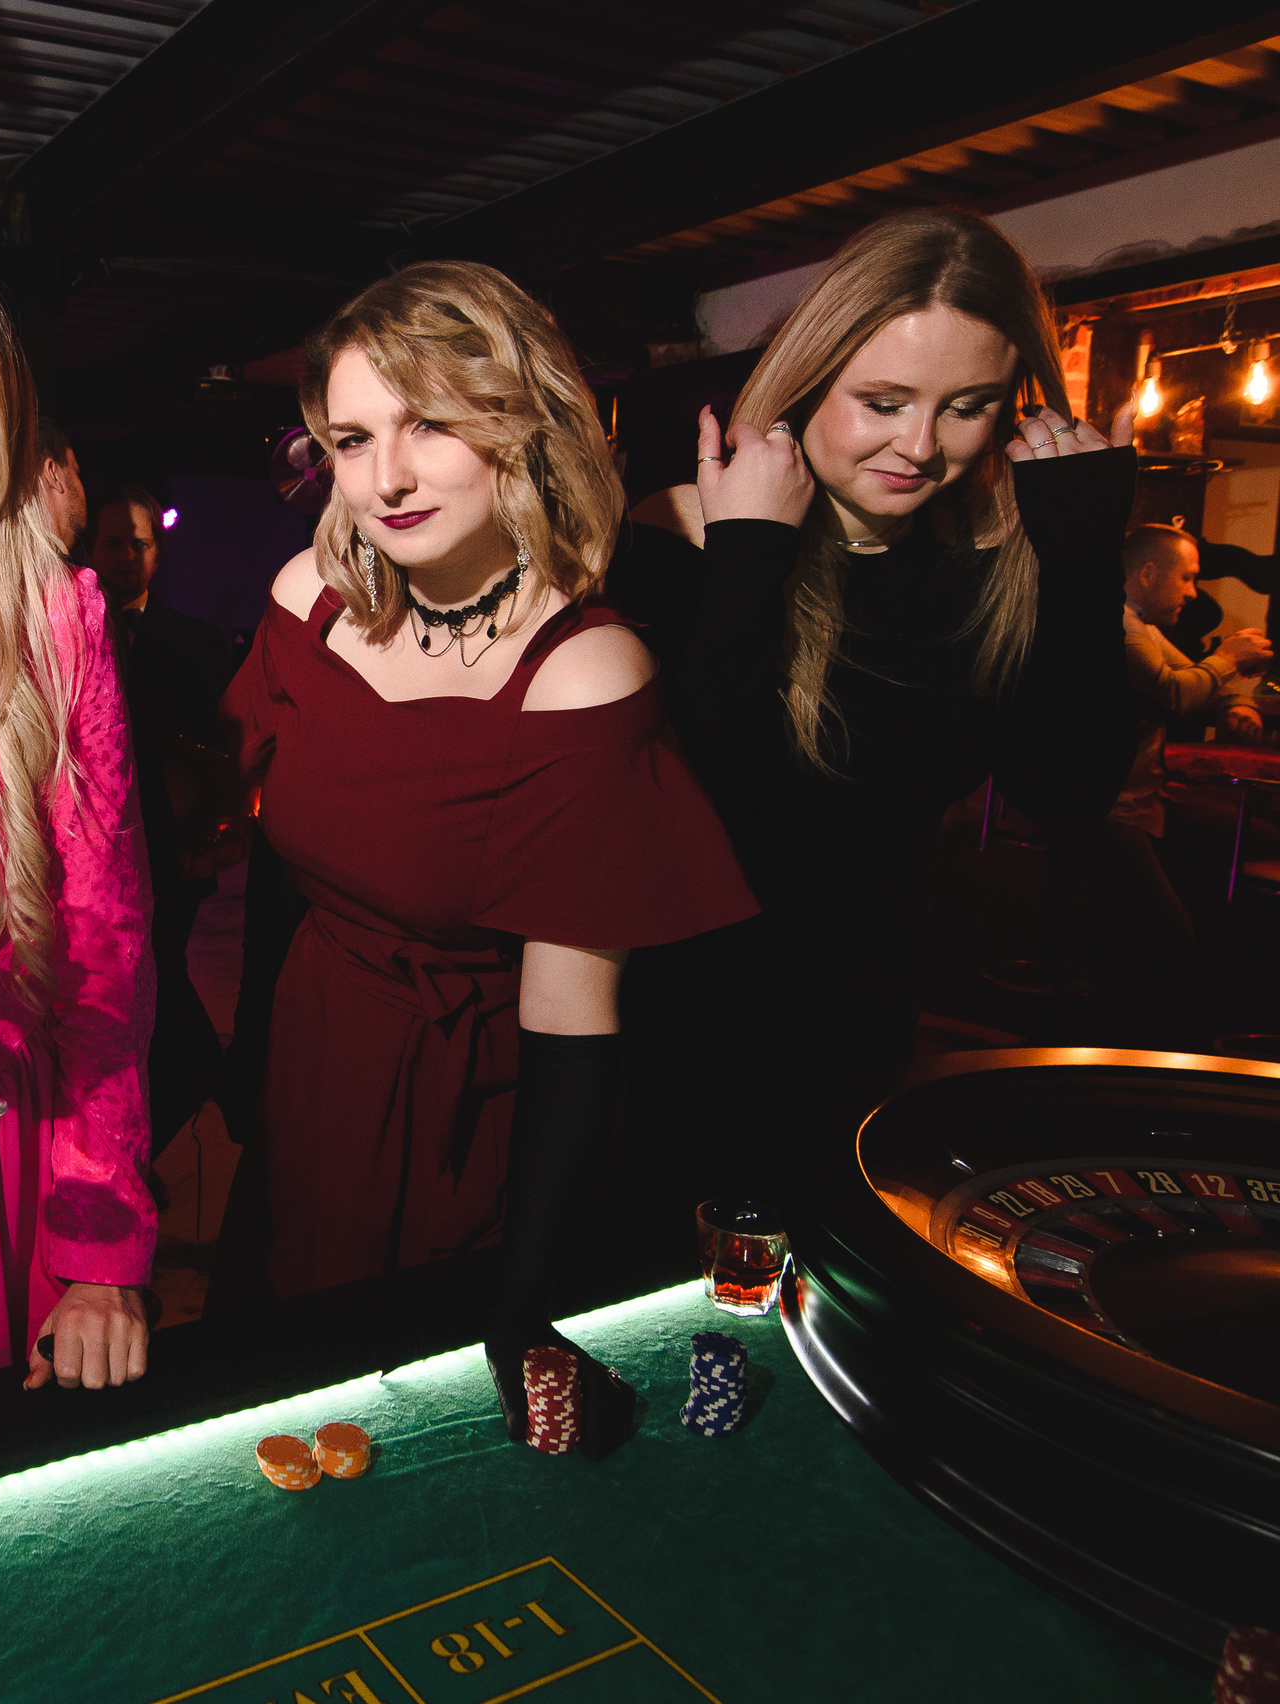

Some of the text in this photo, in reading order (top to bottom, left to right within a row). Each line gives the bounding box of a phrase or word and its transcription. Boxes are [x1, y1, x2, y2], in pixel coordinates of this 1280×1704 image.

[1017, 1180, 1062, 1207] 18
[1049, 1174, 1096, 1199] 29
[1094, 1171, 1122, 1194] 7
[1136, 1171, 1183, 1194] 28
[1190, 1173, 1235, 1198] 12
[988, 1190, 1036, 1218] 22
[972, 1206, 1012, 1229] 9
[959, 1221, 1003, 1248] 31
[429, 1598, 575, 1675] 1-18
